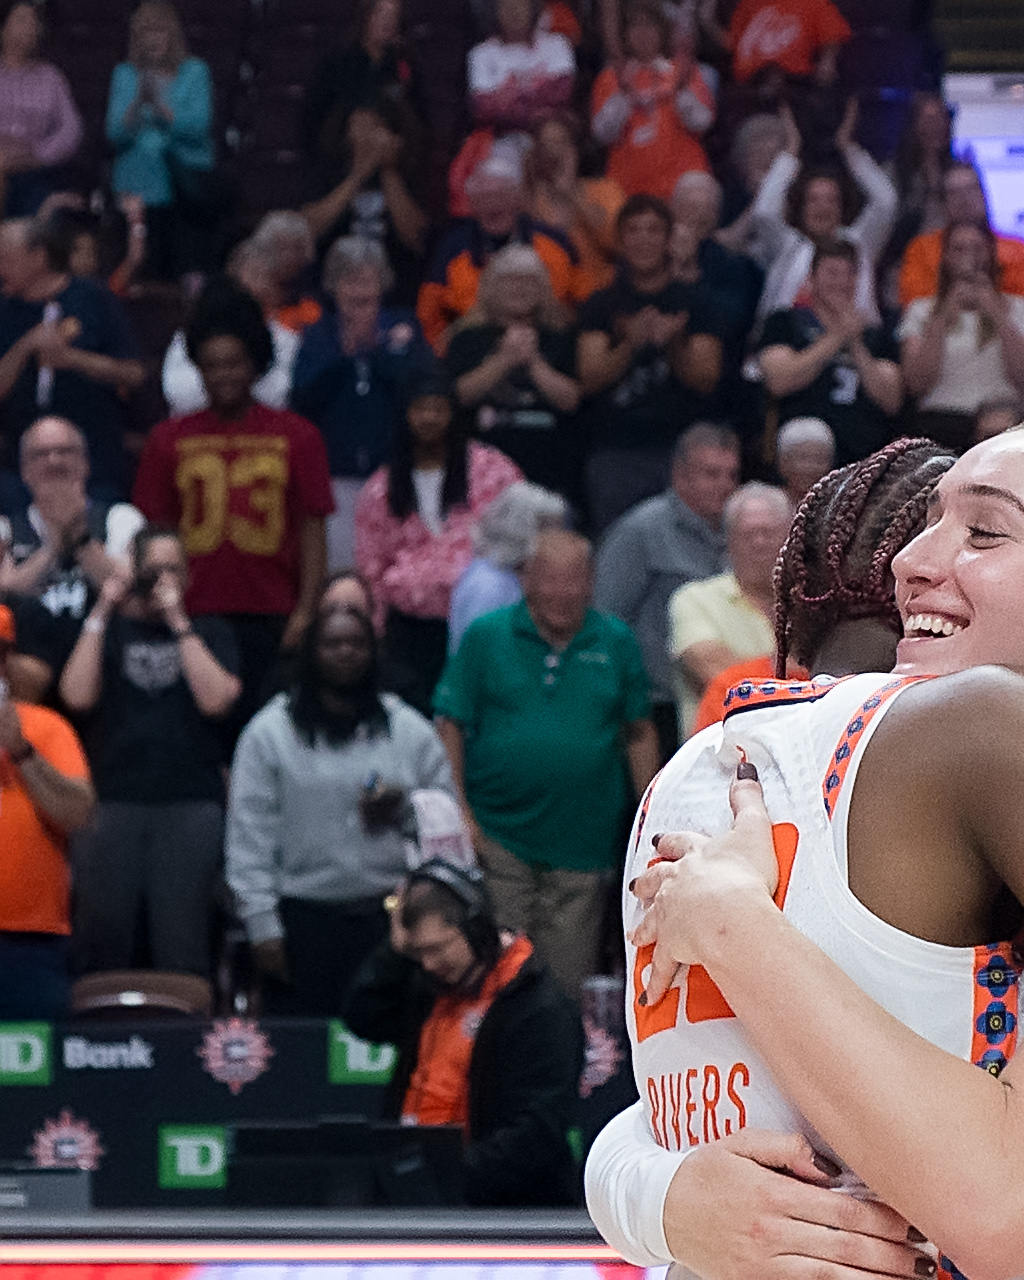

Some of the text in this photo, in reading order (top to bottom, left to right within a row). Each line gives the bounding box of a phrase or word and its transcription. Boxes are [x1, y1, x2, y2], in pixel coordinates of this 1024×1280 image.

[63, 1036, 154, 1069] Bank
[647, 1063, 749, 1151] RIVERS
[166, 1135, 224, 1176] TD
